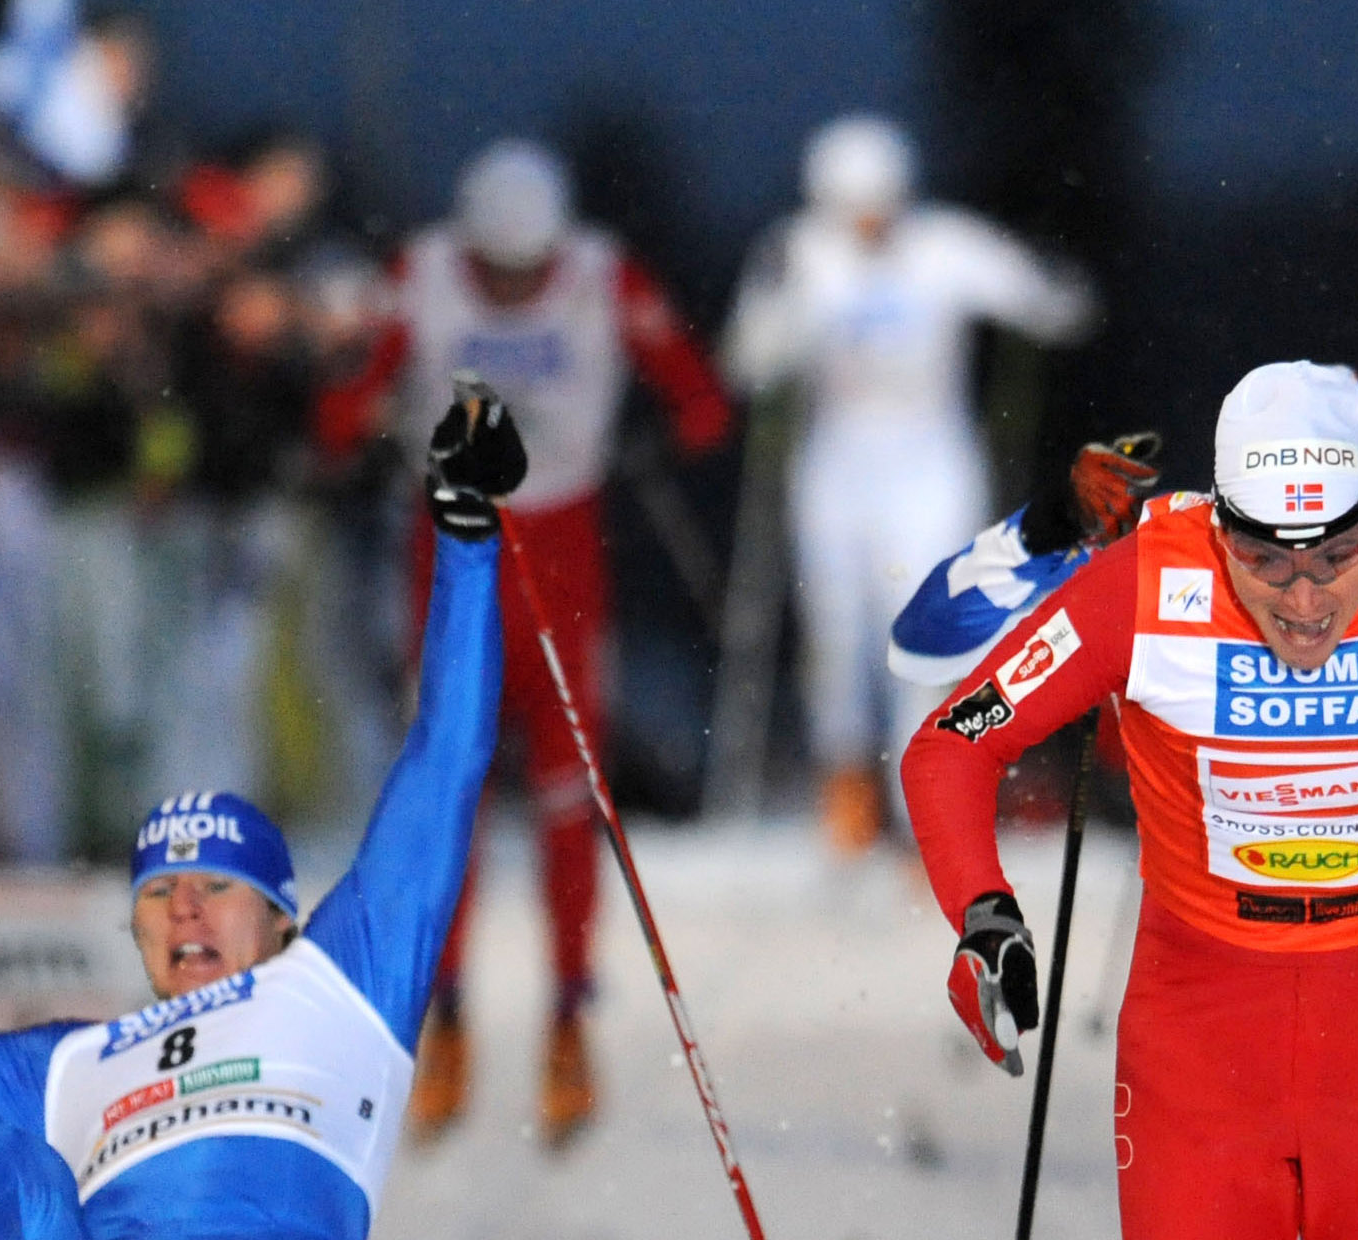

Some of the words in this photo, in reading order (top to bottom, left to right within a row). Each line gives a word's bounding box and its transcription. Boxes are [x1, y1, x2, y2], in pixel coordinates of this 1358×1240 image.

[1246, 448, 1298, 469] DnB
[1303, 447, 1355, 468] NOR
[157, 1026, 197, 1071] 8
